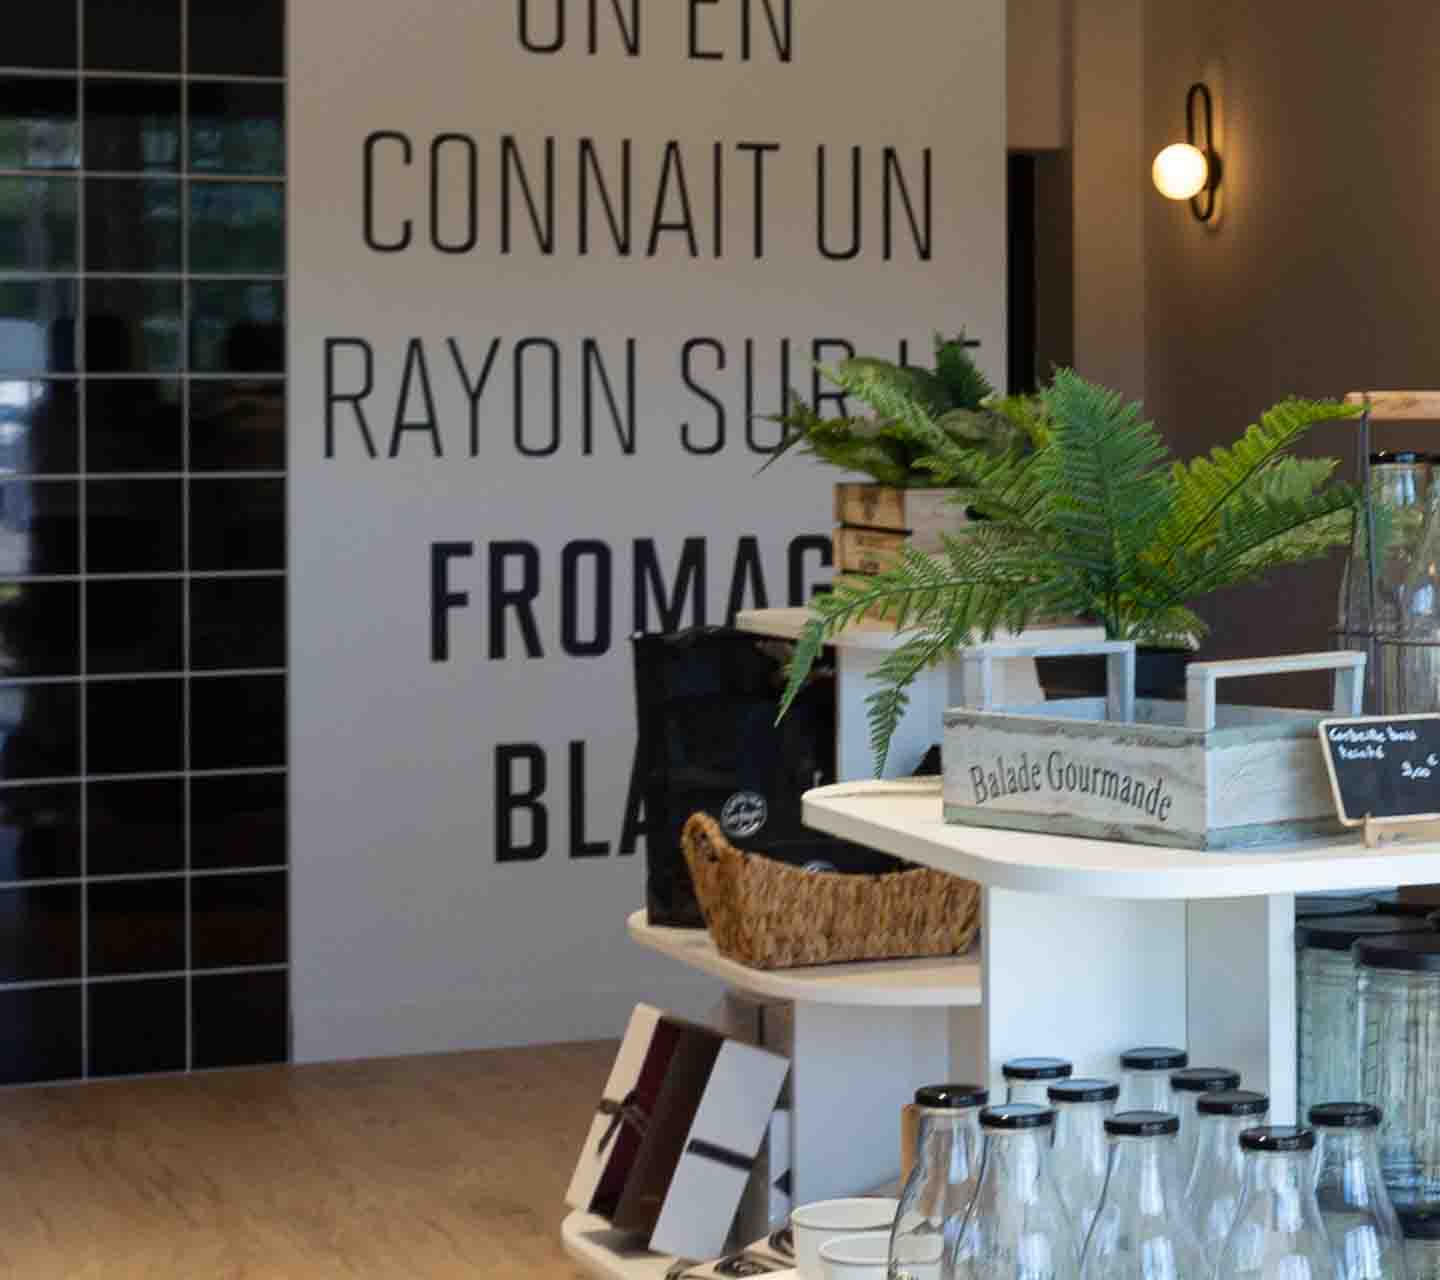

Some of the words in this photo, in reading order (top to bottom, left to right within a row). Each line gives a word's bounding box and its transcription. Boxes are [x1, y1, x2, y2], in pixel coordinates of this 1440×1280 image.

[362, 129, 781, 259] CONNAIT
[815, 144, 933, 262] UN
[322, 336, 638, 459] RAYON
[679, 336, 857, 458] SUR
[968, 755, 1042, 806] Balade
[1045, 749, 1173, 823] Gourmande
